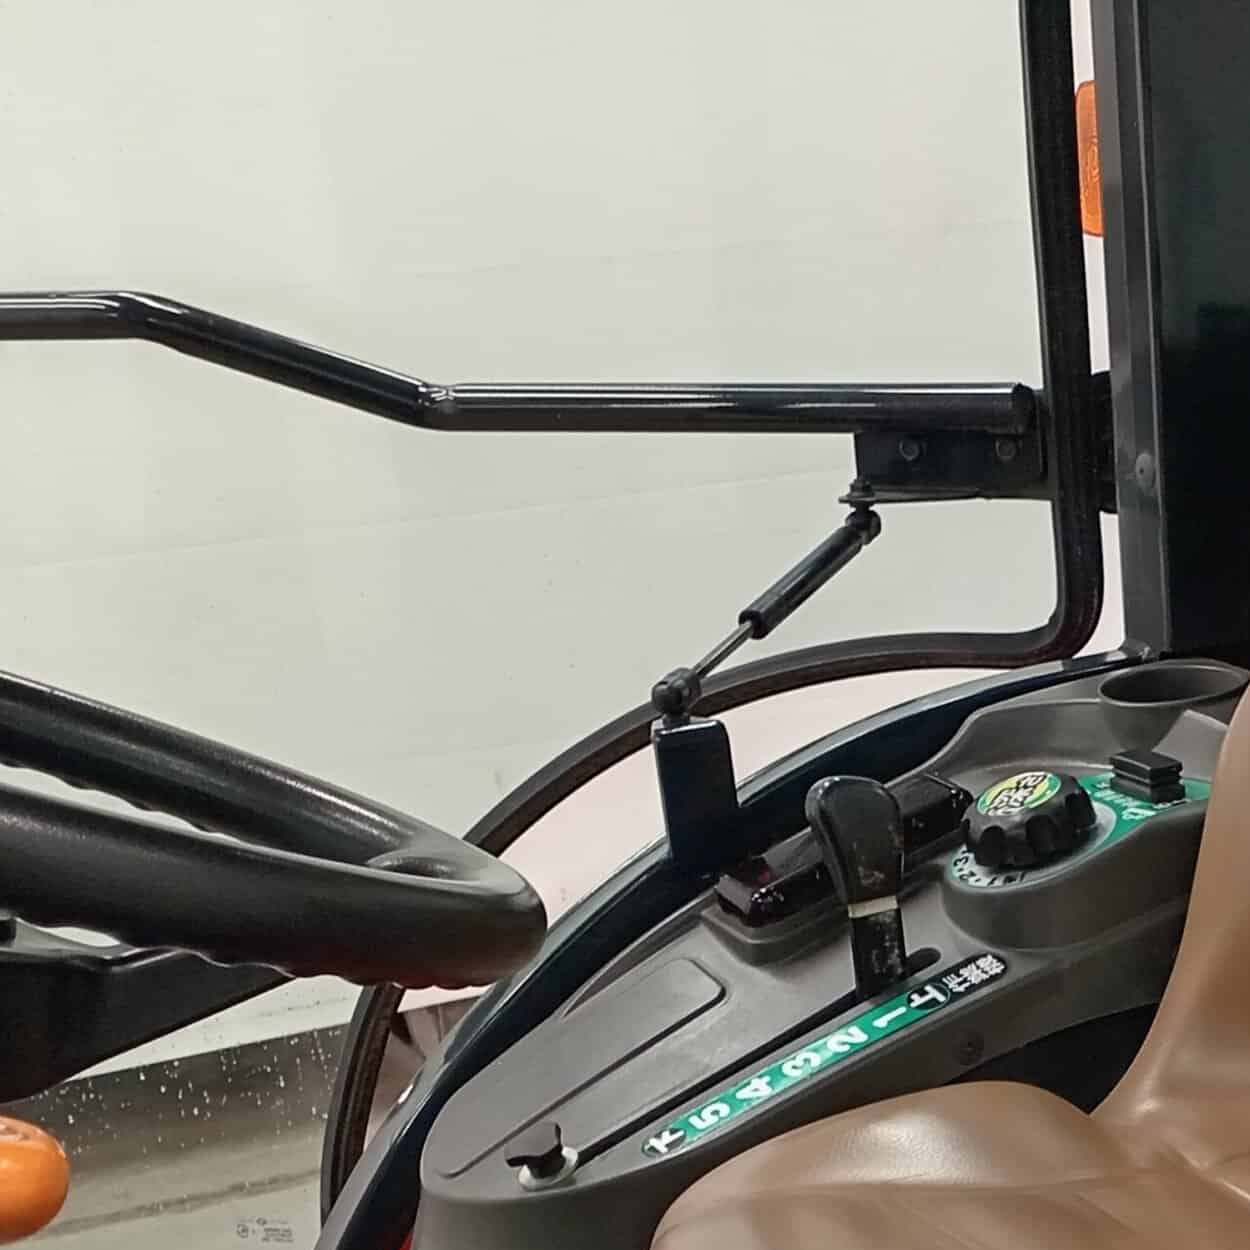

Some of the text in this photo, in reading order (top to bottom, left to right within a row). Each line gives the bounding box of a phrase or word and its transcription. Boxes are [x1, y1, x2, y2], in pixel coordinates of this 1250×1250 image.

[872, 1006, 907, 1028] 1
[827, 1025, 868, 1052] 2
[782, 1052, 821, 1077] 3
[736, 1075, 772, 1099] 4
[688, 1102, 730, 1129] 5
